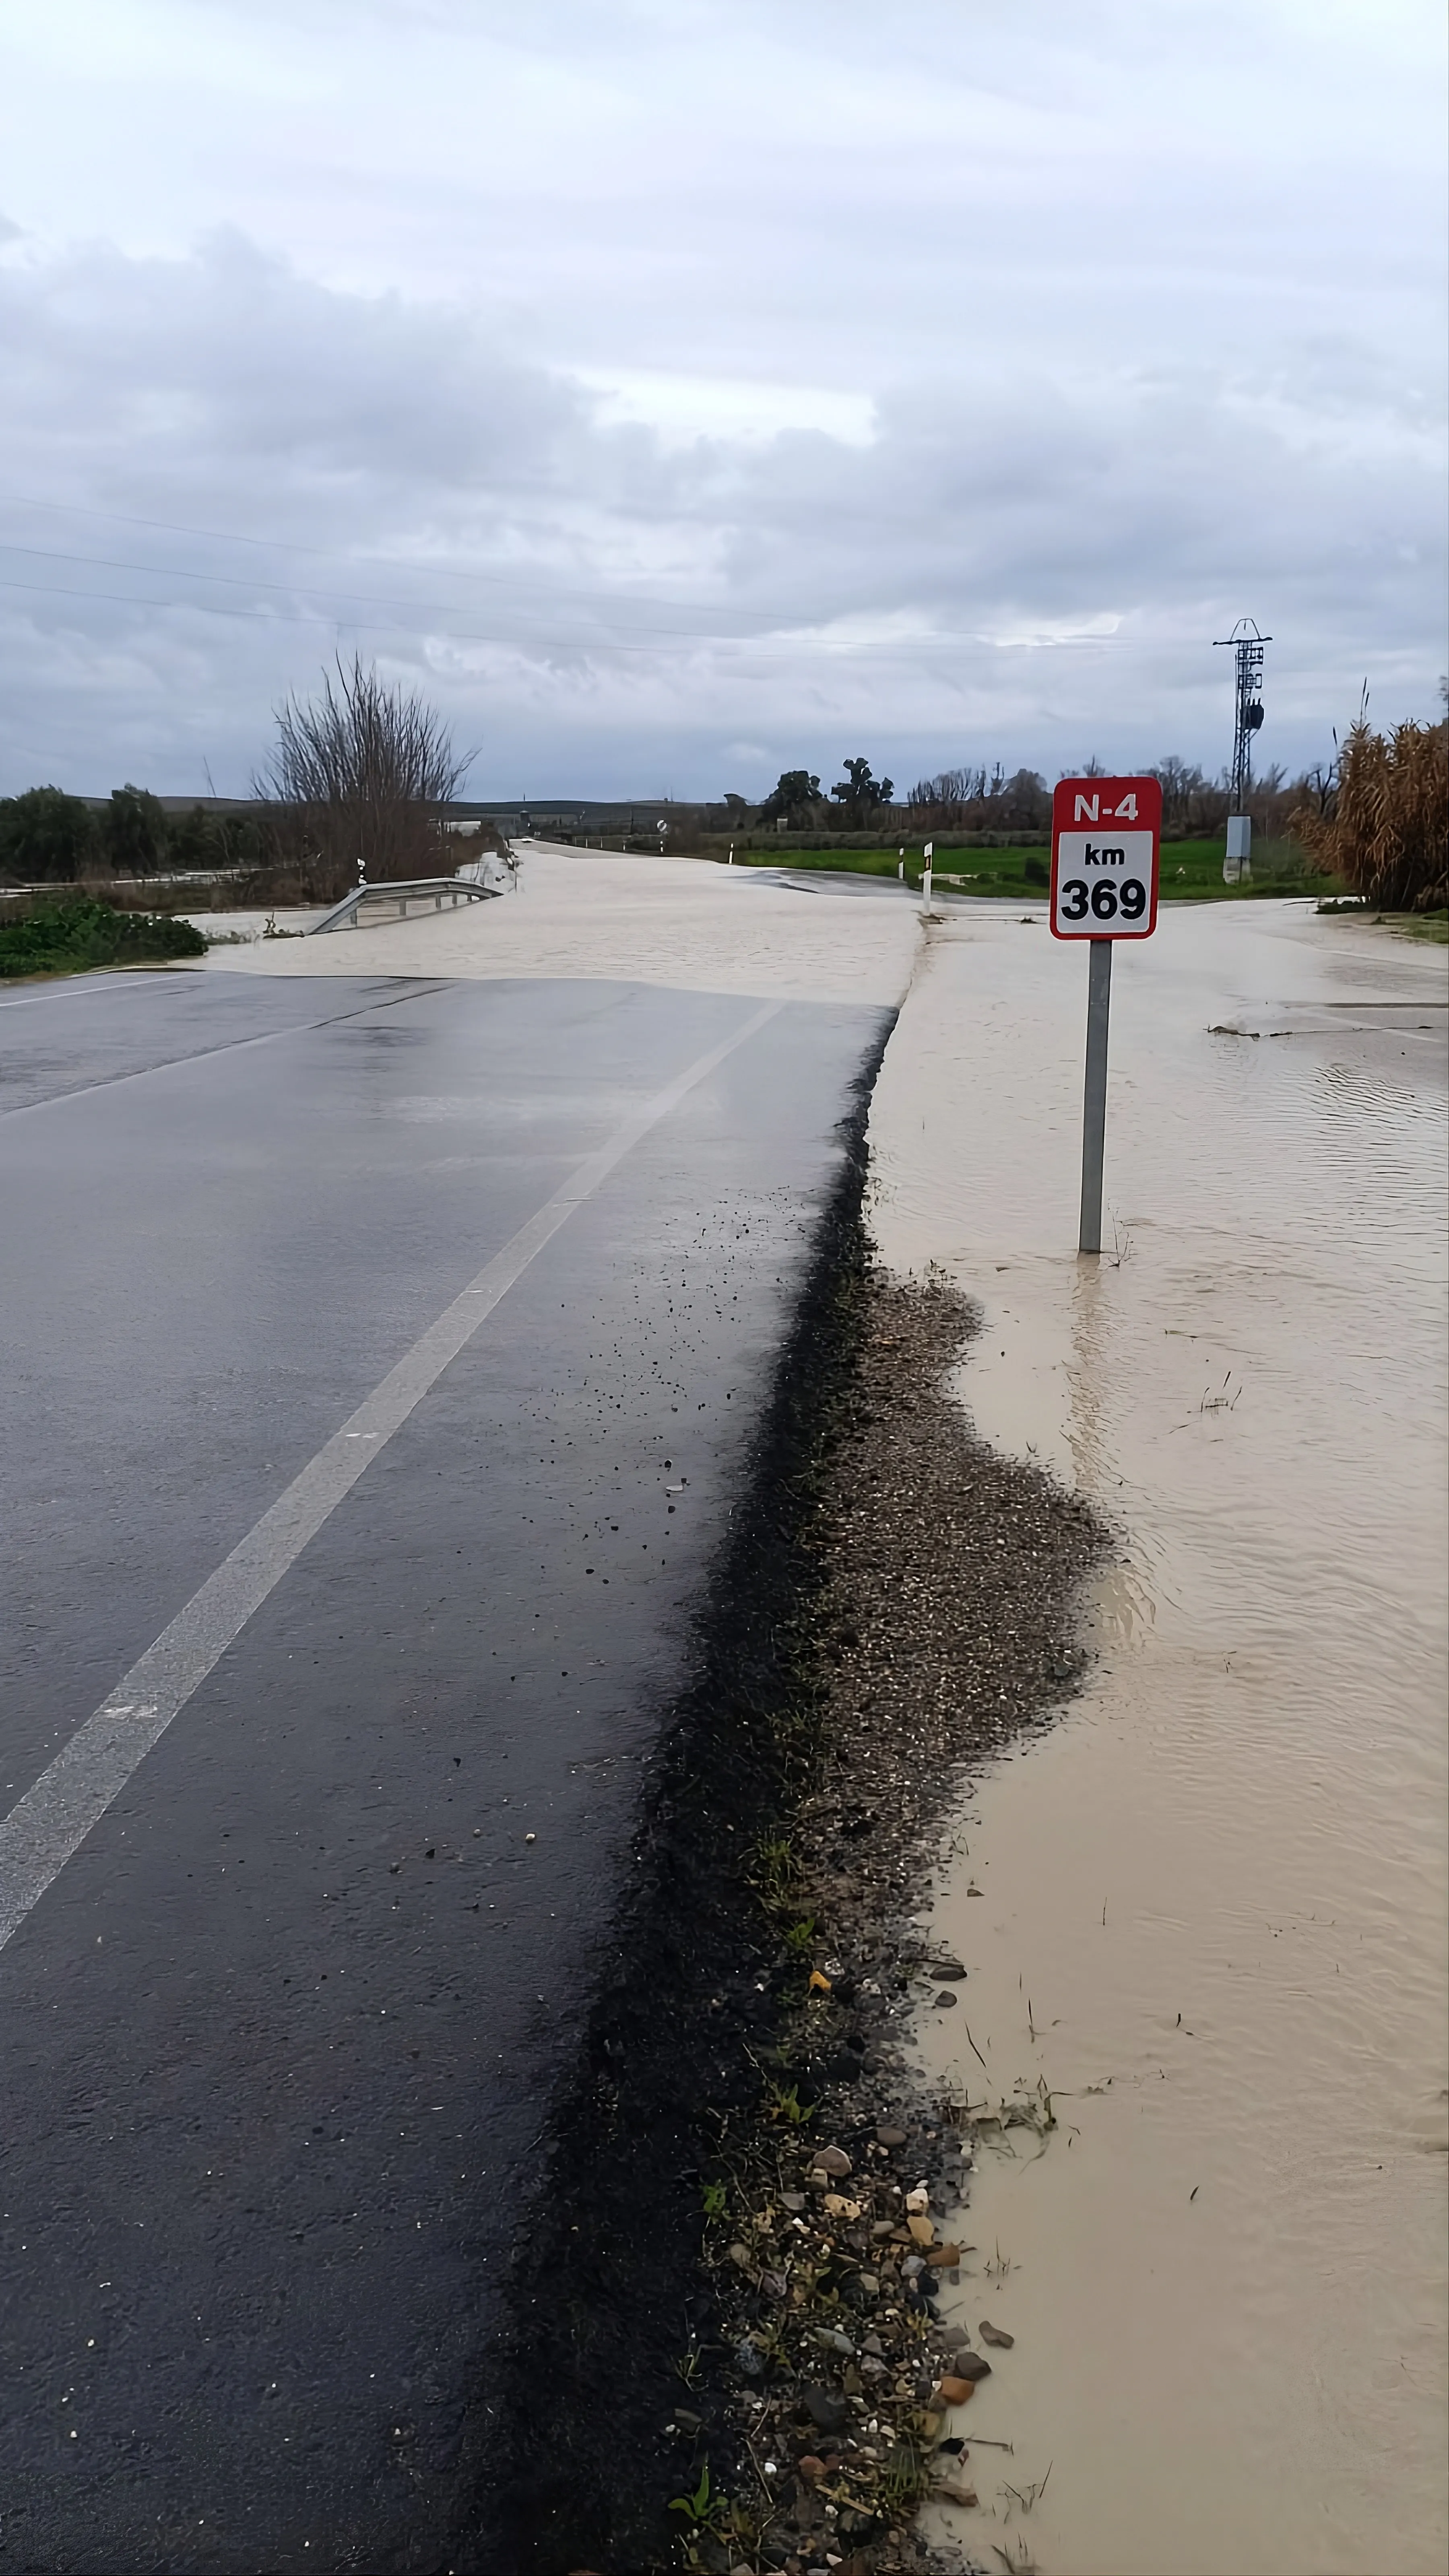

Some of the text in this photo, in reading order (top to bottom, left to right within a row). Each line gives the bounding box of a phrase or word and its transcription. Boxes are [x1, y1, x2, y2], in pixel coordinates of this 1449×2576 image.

[1074, 793, 1138, 822] N-4
[1084, 843, 1125, 865] km
[1061, 879, 1146, 920] 369
